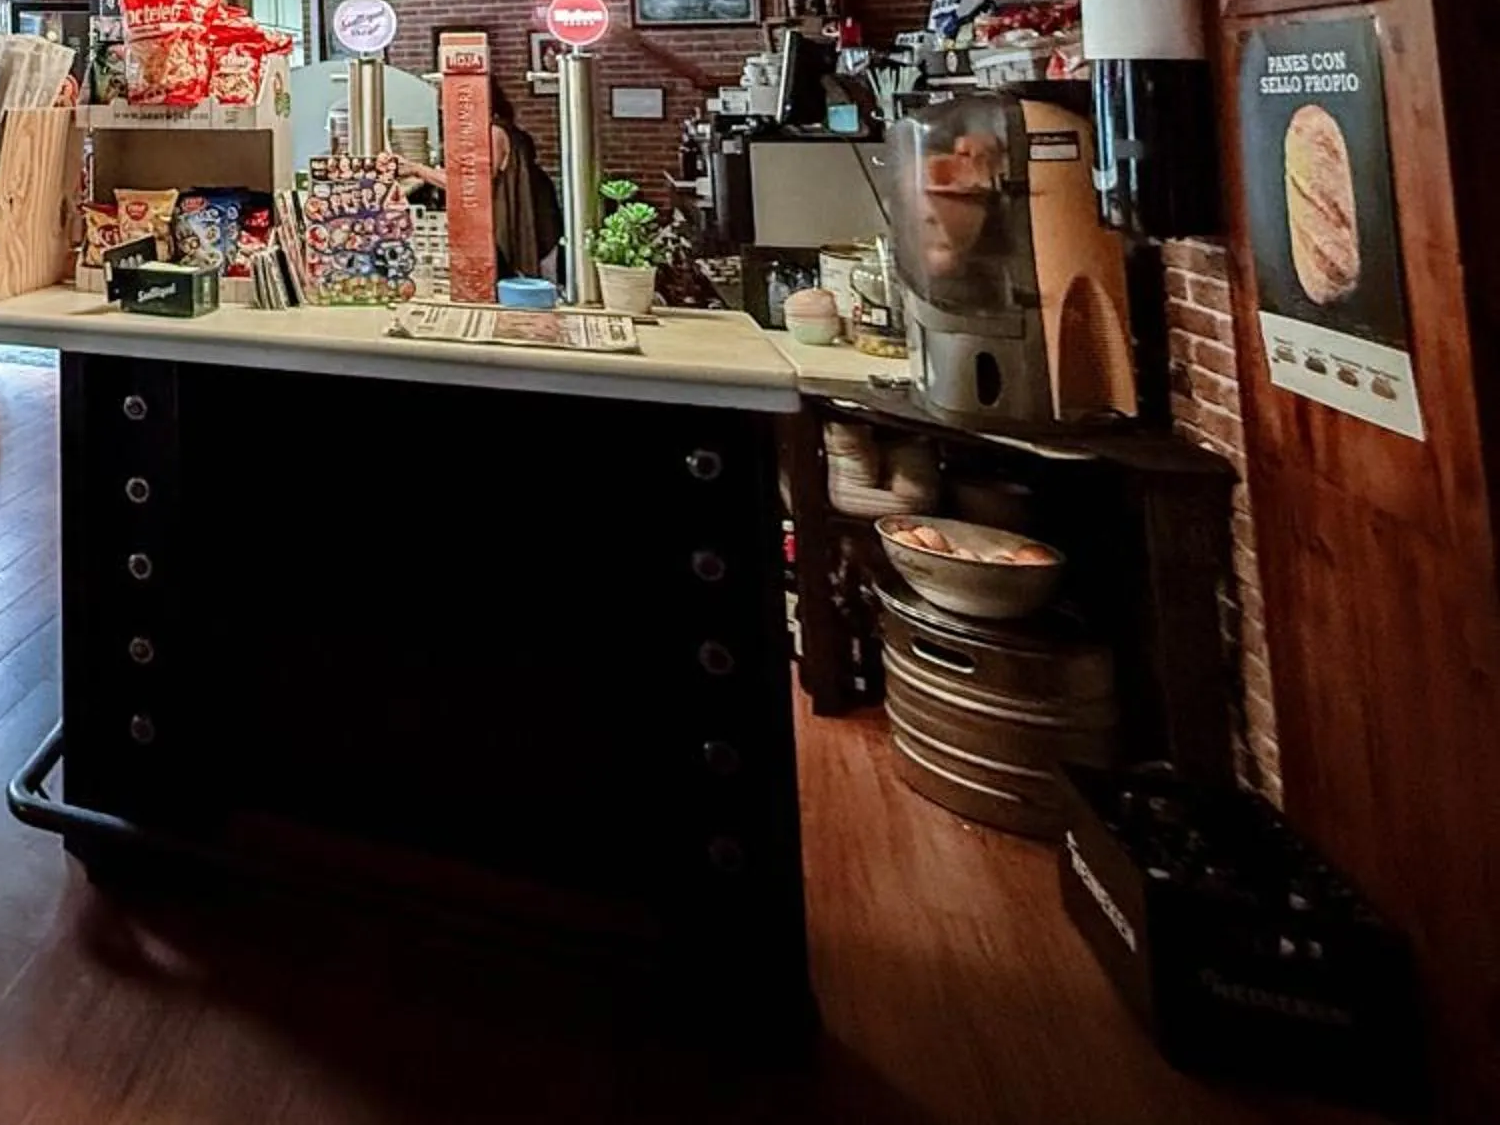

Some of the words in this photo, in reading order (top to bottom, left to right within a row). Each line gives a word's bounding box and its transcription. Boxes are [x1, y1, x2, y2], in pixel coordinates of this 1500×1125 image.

[1267, 54, 1309, 74] PANES
[1311, 51, 1347, 72] CON
[1260, 74, 1302, 94] SELLO
[1303, 72, 1359, 92] PROPIO
